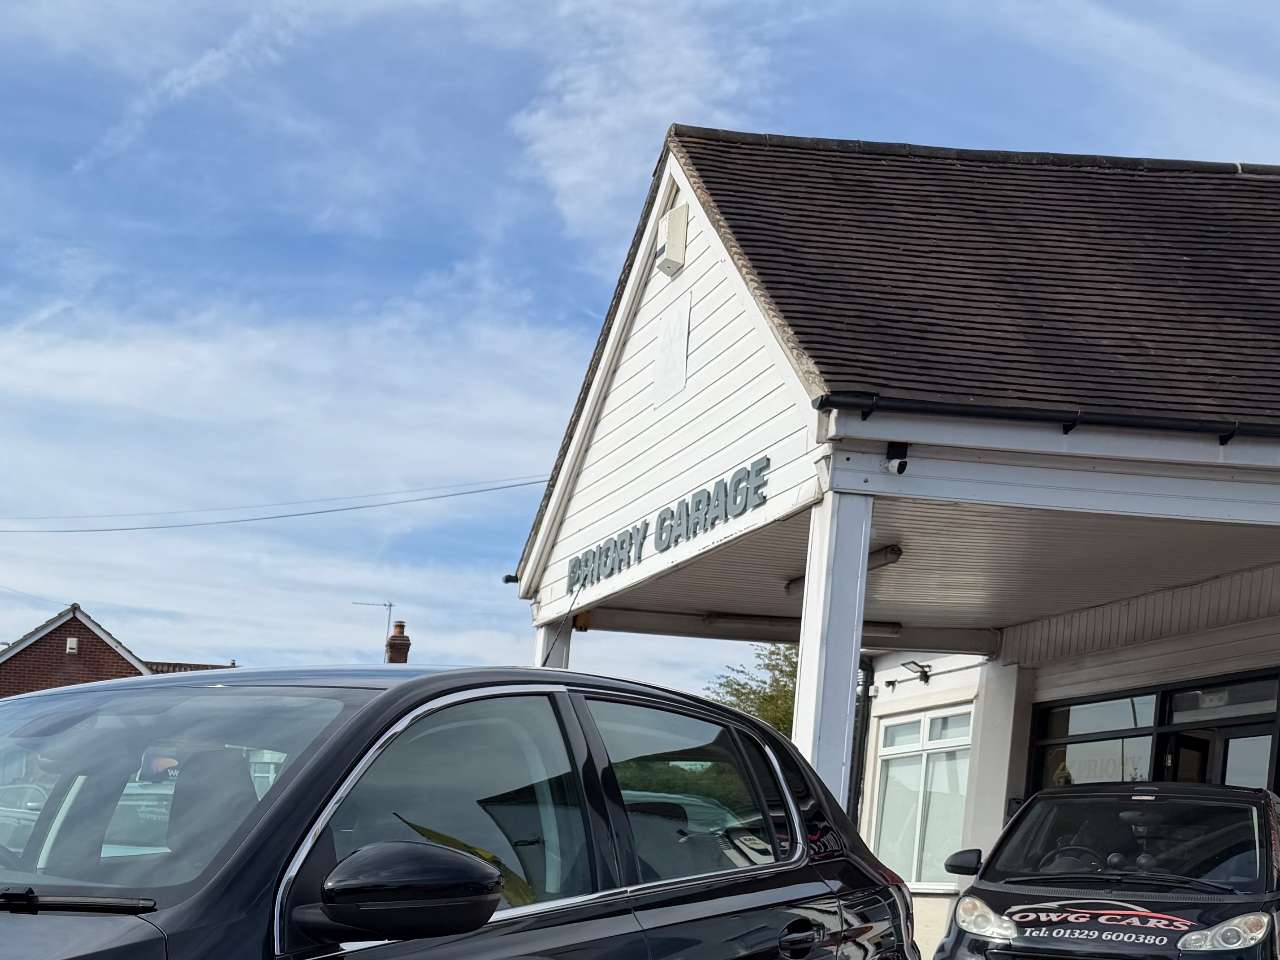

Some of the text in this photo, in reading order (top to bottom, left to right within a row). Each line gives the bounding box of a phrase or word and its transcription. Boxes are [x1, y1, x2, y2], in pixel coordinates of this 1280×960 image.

[567, 454, 771, 595] PRIORY GARAGE
[1011, 912, 1192, 931] OWG CARS
[1024, 927, 1168, 946] Tel: 01329 600380
